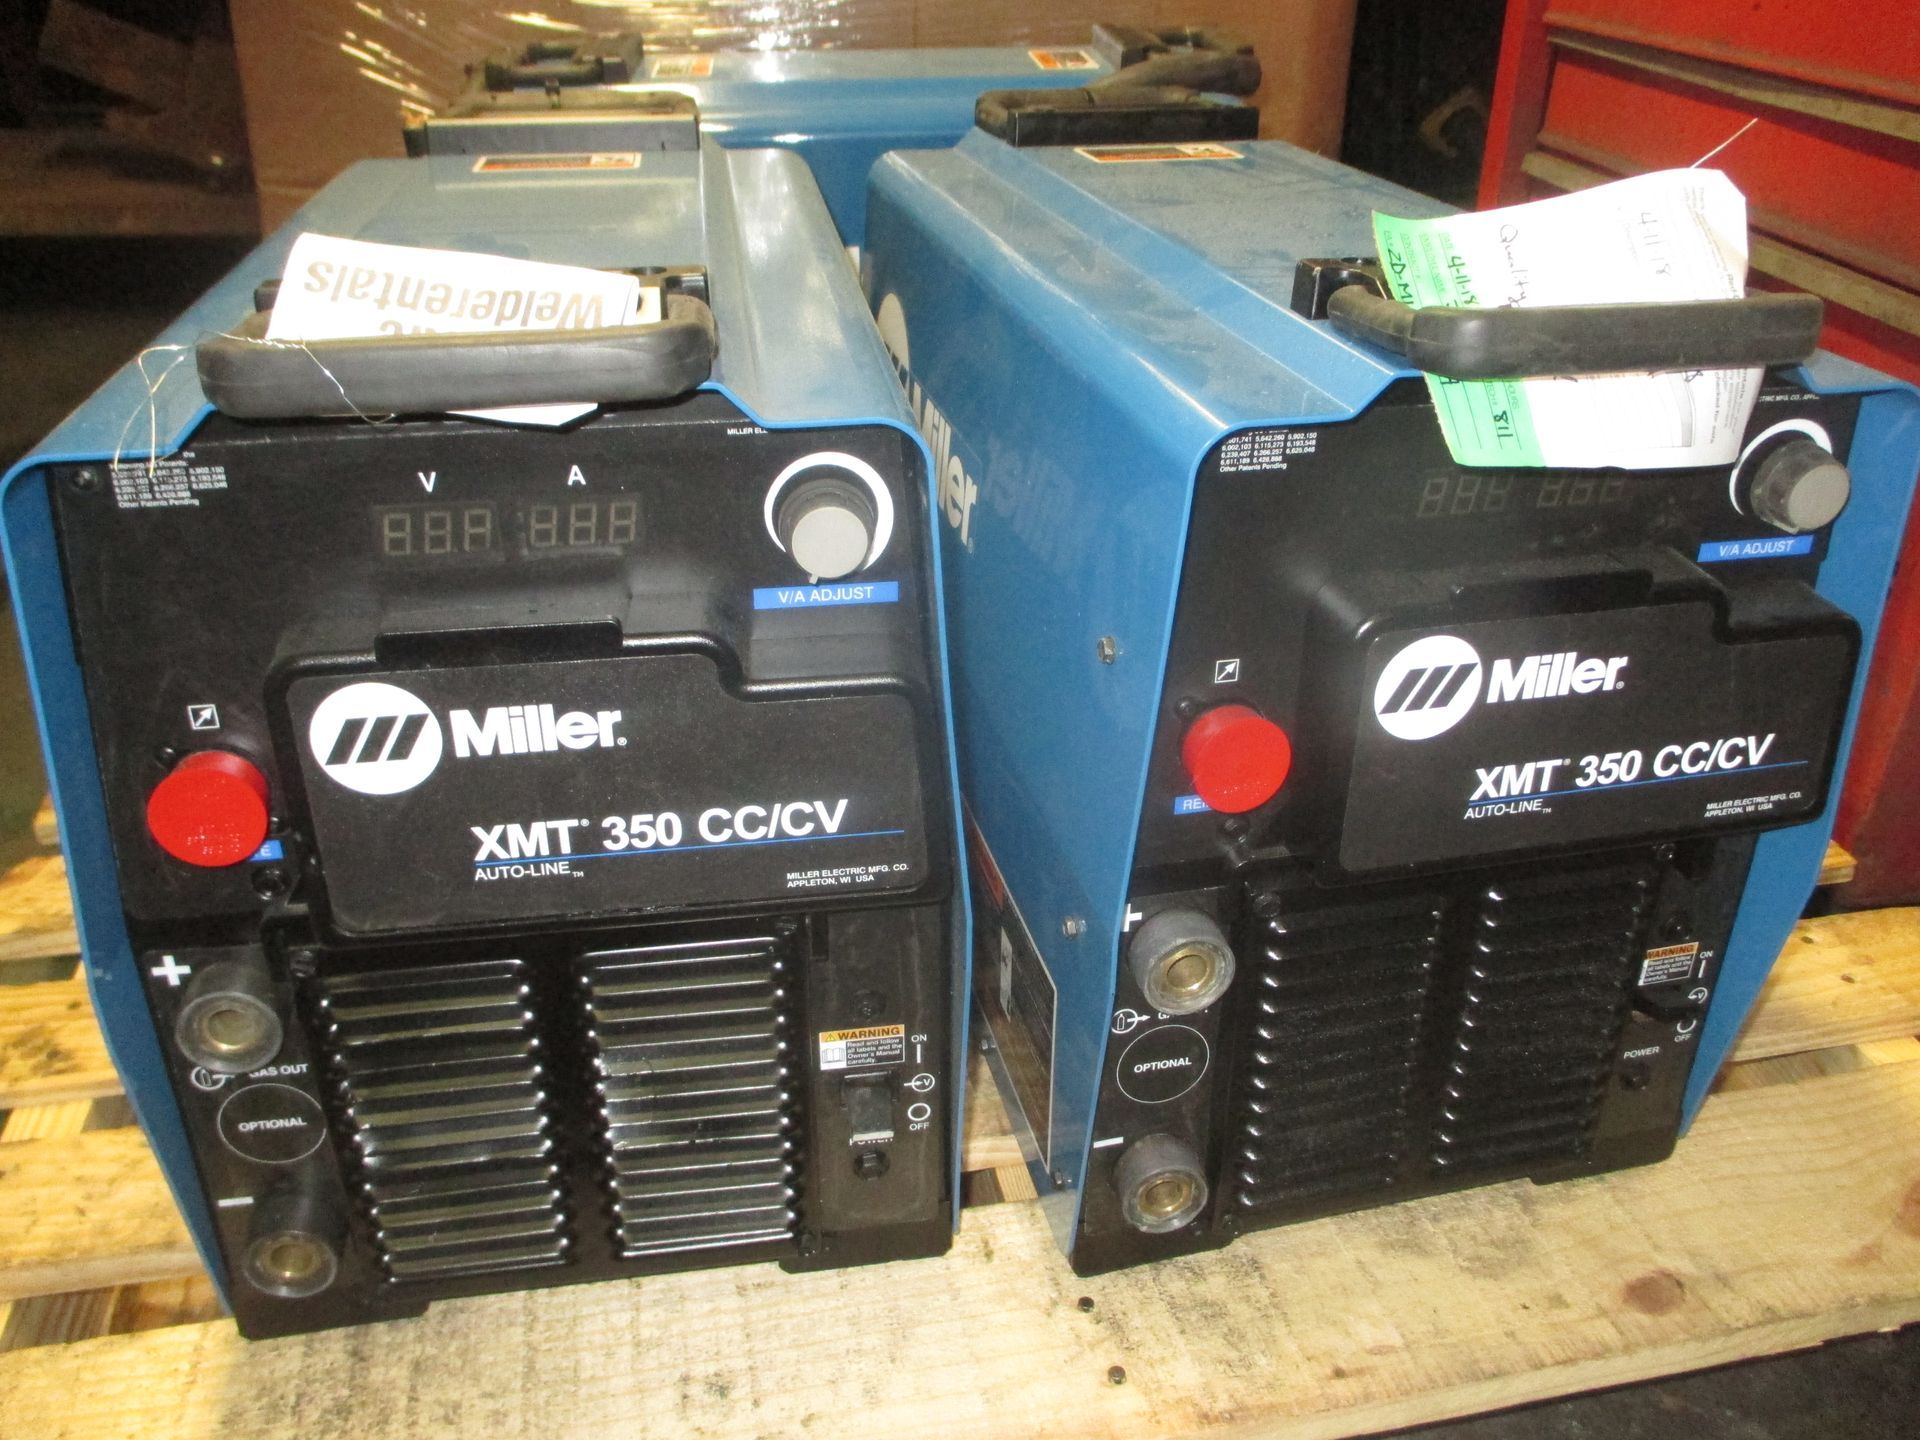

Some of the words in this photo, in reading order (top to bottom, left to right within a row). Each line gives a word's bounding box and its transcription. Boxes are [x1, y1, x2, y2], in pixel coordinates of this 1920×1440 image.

[727, 427, 753, 436] MILLER
[418, 472, 437, 493] V
[568, 465, 587, 485] A
[1719, 544, 1739, 557] V/A
[1742, 540, 1795, 555] ADJUST
[778, 588, 806, 604] V/A
[809, 586, 874, 602] ADJUST
[1575, 749, 1642, 788] 350
[1653, 733, 1776, 777] CC/CV
[1706, 799, 1733, 810] MILLER
[1733, 795, 1769, 806] ELECTRIC
[1757, 803, 1773, 811] USA
[601, 812, 682, 851] 350
[699, 799, 848, 843] CC/CV
[786, 869, 820, 880] MILLER
[821, 866, 866, 878] ELECTRIC
[867, 864, 891, 874] MFG.
[892, 863, 909, 871] CO.
[787, 877, 838, 888] APPLETON,
[839, 876, 851, 884] WI
[855, 874, 875, 882] USA
[1700, 950, 1713, 958] ON
[838, 1026, 900, 1041] WARNING
[911, 1034, 927, 1042] ON
[1674, 1033, 1692, 1042] OFF
[1623, 1046, 1660, 1059] POWER
[280, 1063, 309, 1075] OUT
[1133, 1056, 1192, 1073] OPTIONAL
[238, 1116, 307, 1132] OPTIONAL
[909, 1122, 930, 1131] OFF
